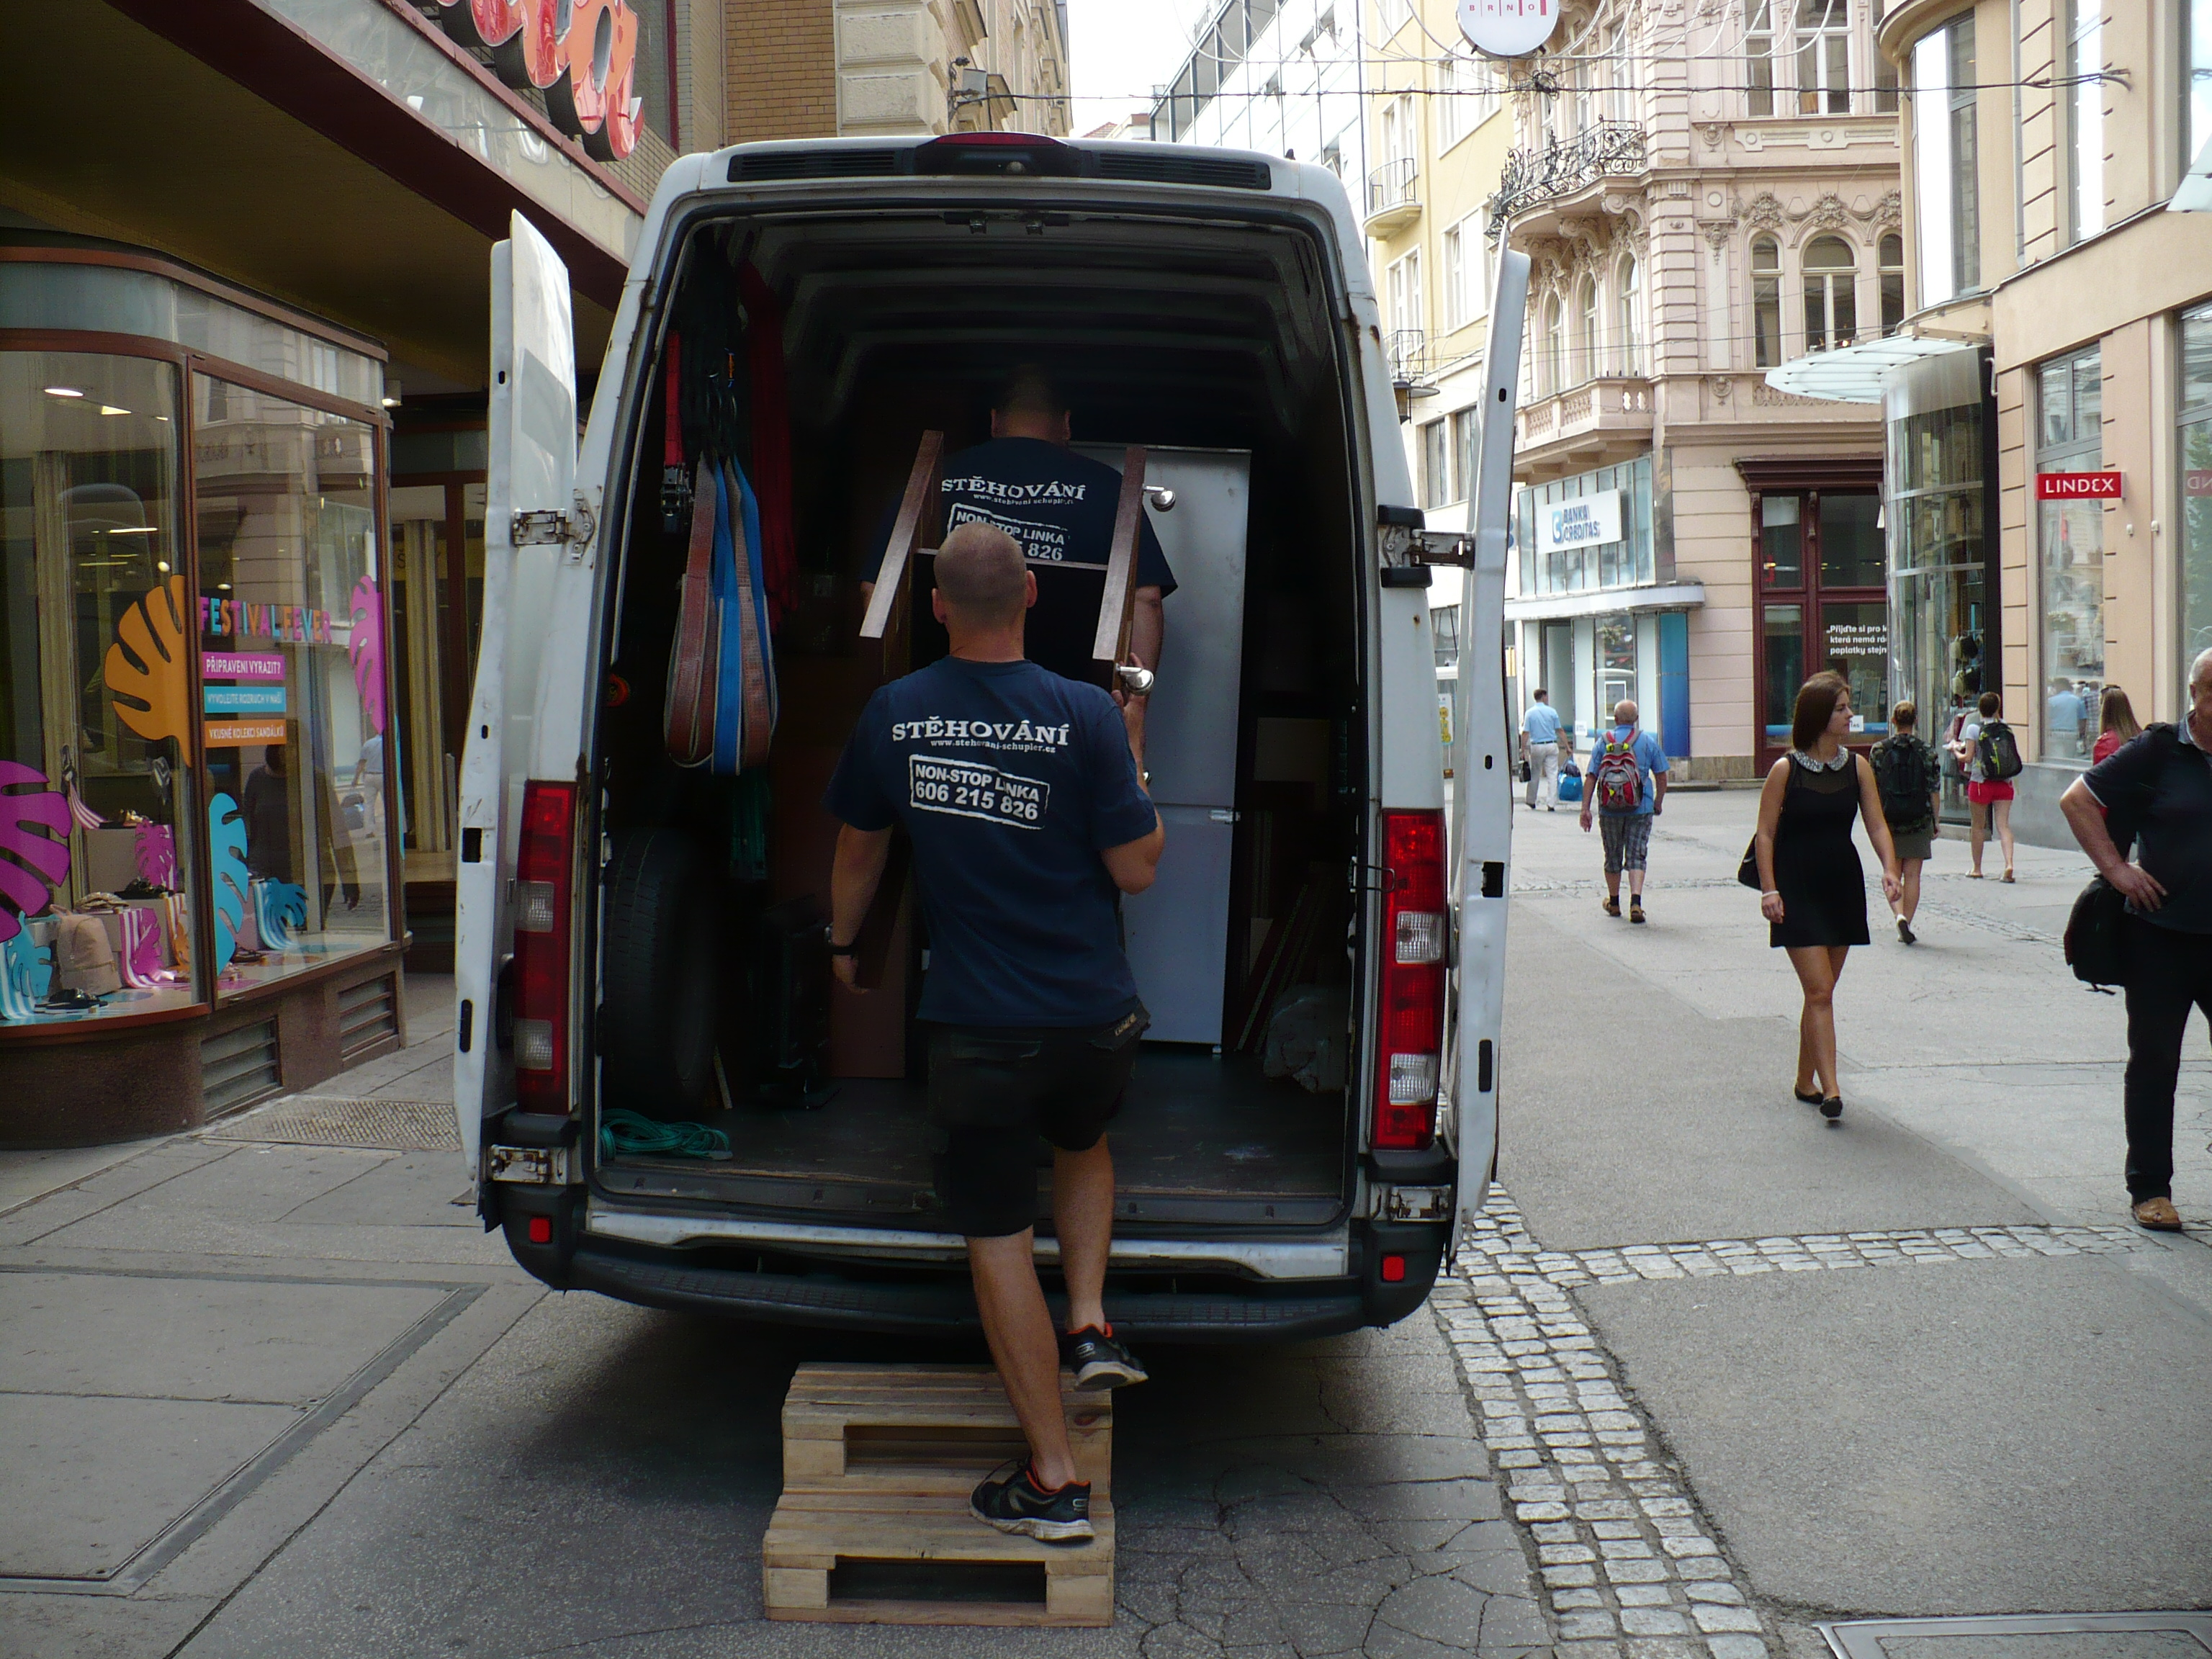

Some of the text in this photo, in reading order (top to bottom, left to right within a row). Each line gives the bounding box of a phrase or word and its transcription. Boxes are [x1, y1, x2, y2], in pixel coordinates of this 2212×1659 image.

[941, 475, 1086, 500] STĚHOVÁNÍ
[2046, 478, 2114, 493] LINDEX
[1564, 505, 1588, 523] BANKA
[1023, 529, 1065, 545] LINKA
[1564, 521, 1599, 541] CREDITAS
[1028, 543, 1063, 561] 826
[199, 597, 332, 644] FESTIVAL FEVER
[1858, 624, 1866, 633] si
[1830, 646, 1866, 655] poplatky
[206, 656, 281, 675] PŘIPRAVENI VYRAZIT?
[892, 716, 1070, 746] STĚHOVÁNÍ
[915, 764, 992, 788] NON-STOP
[915, 781, 1038, 820] 606 215 826
